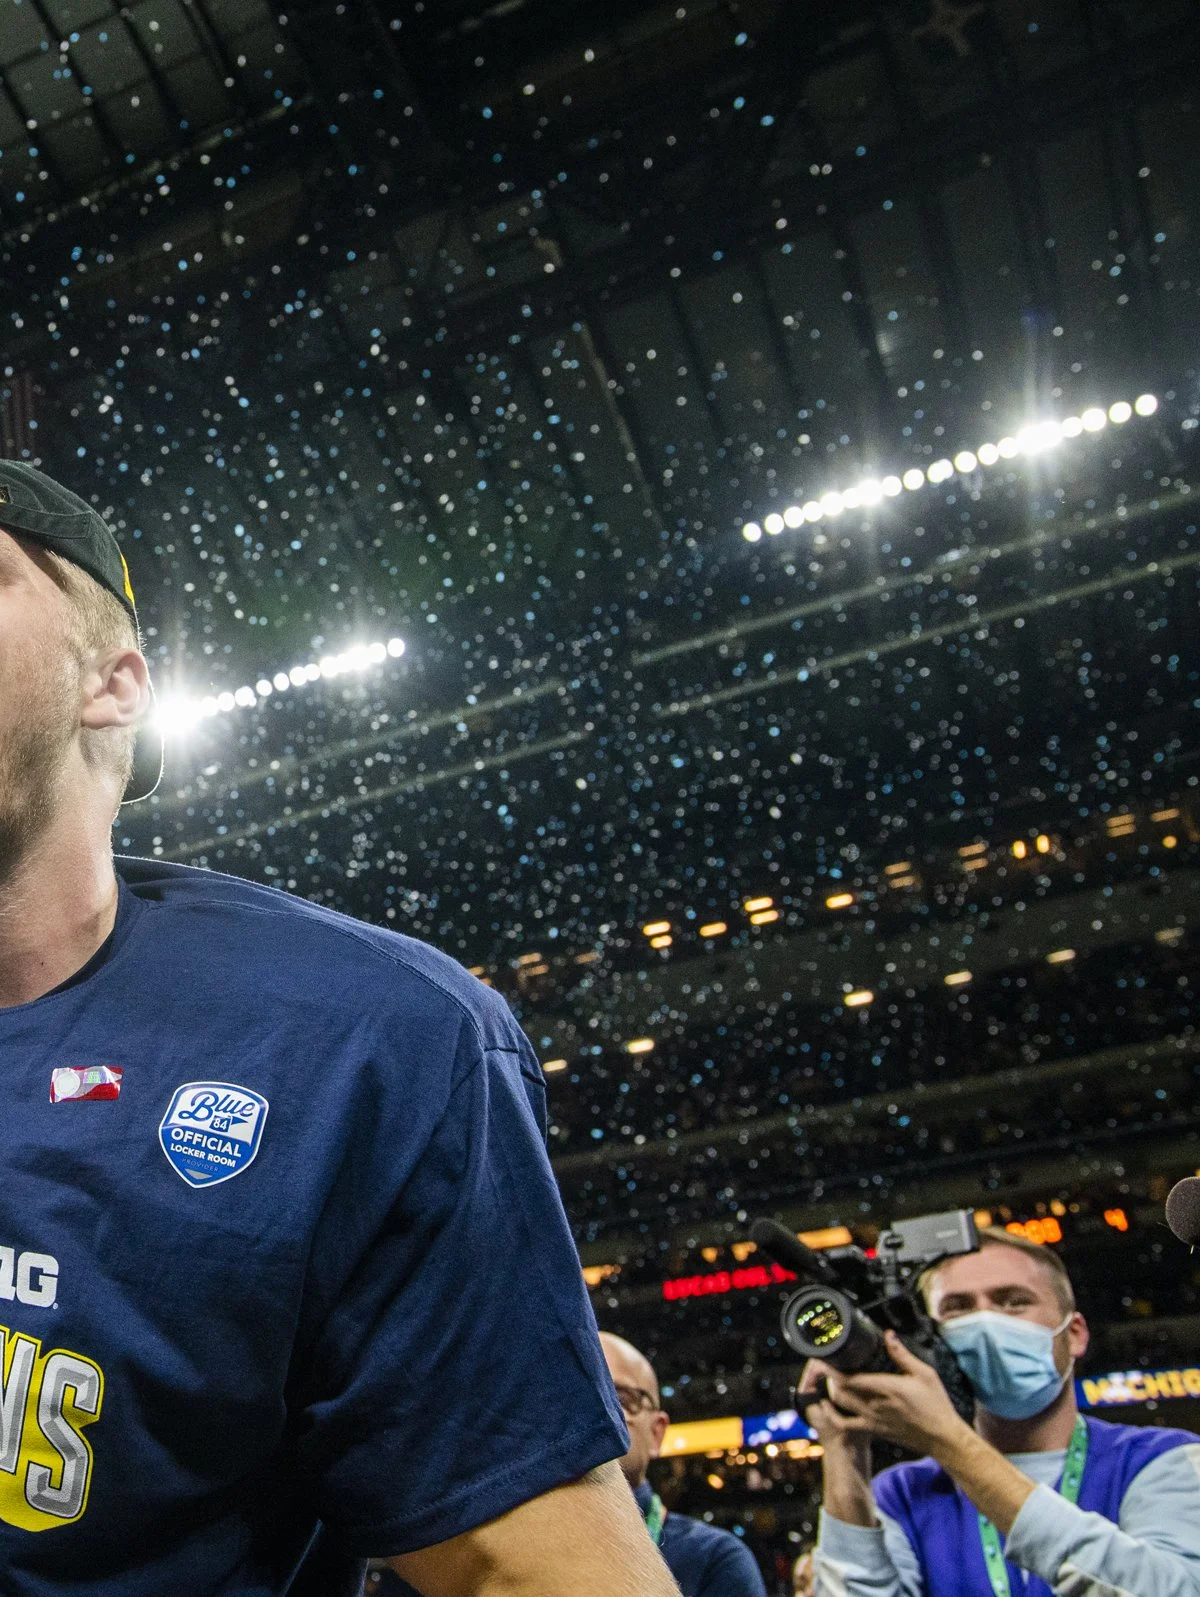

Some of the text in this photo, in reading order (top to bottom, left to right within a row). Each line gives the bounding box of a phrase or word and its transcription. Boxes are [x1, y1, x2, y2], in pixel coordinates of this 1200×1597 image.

[178, 1091, 256, 1122] Blue
[213, 1118, 227, 1130] 84
[171, 1128, 242, 1157] OFFICIAL
[170, 1143, 237, 1168] LOCKER ROOM
[182, 1158, 219, 1172] PROVIDER
